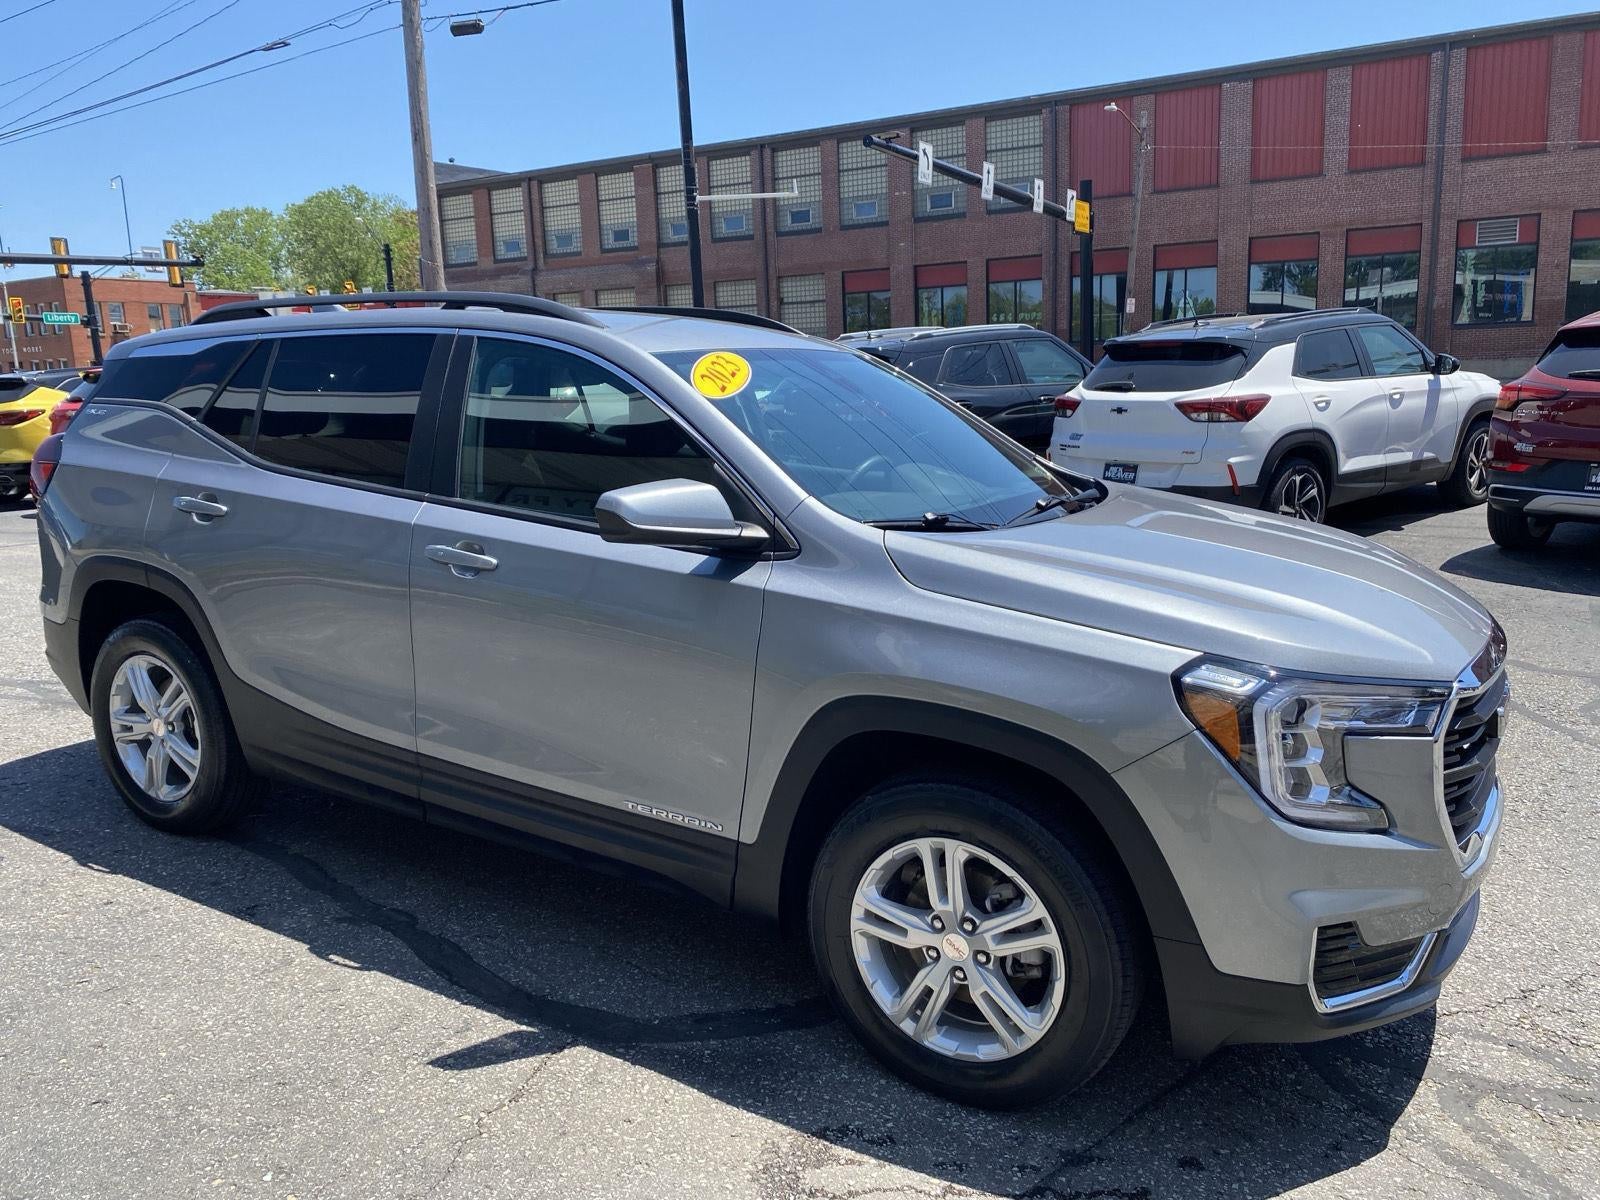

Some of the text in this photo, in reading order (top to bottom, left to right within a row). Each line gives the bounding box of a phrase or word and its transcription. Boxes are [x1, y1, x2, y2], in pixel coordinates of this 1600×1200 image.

[47, 314, 76, 323] Liberty
[700, 354, 741, 393] 2023
[623, 801, 724, 832] TERRAIN
[945, 937, 967, 960] GMC
